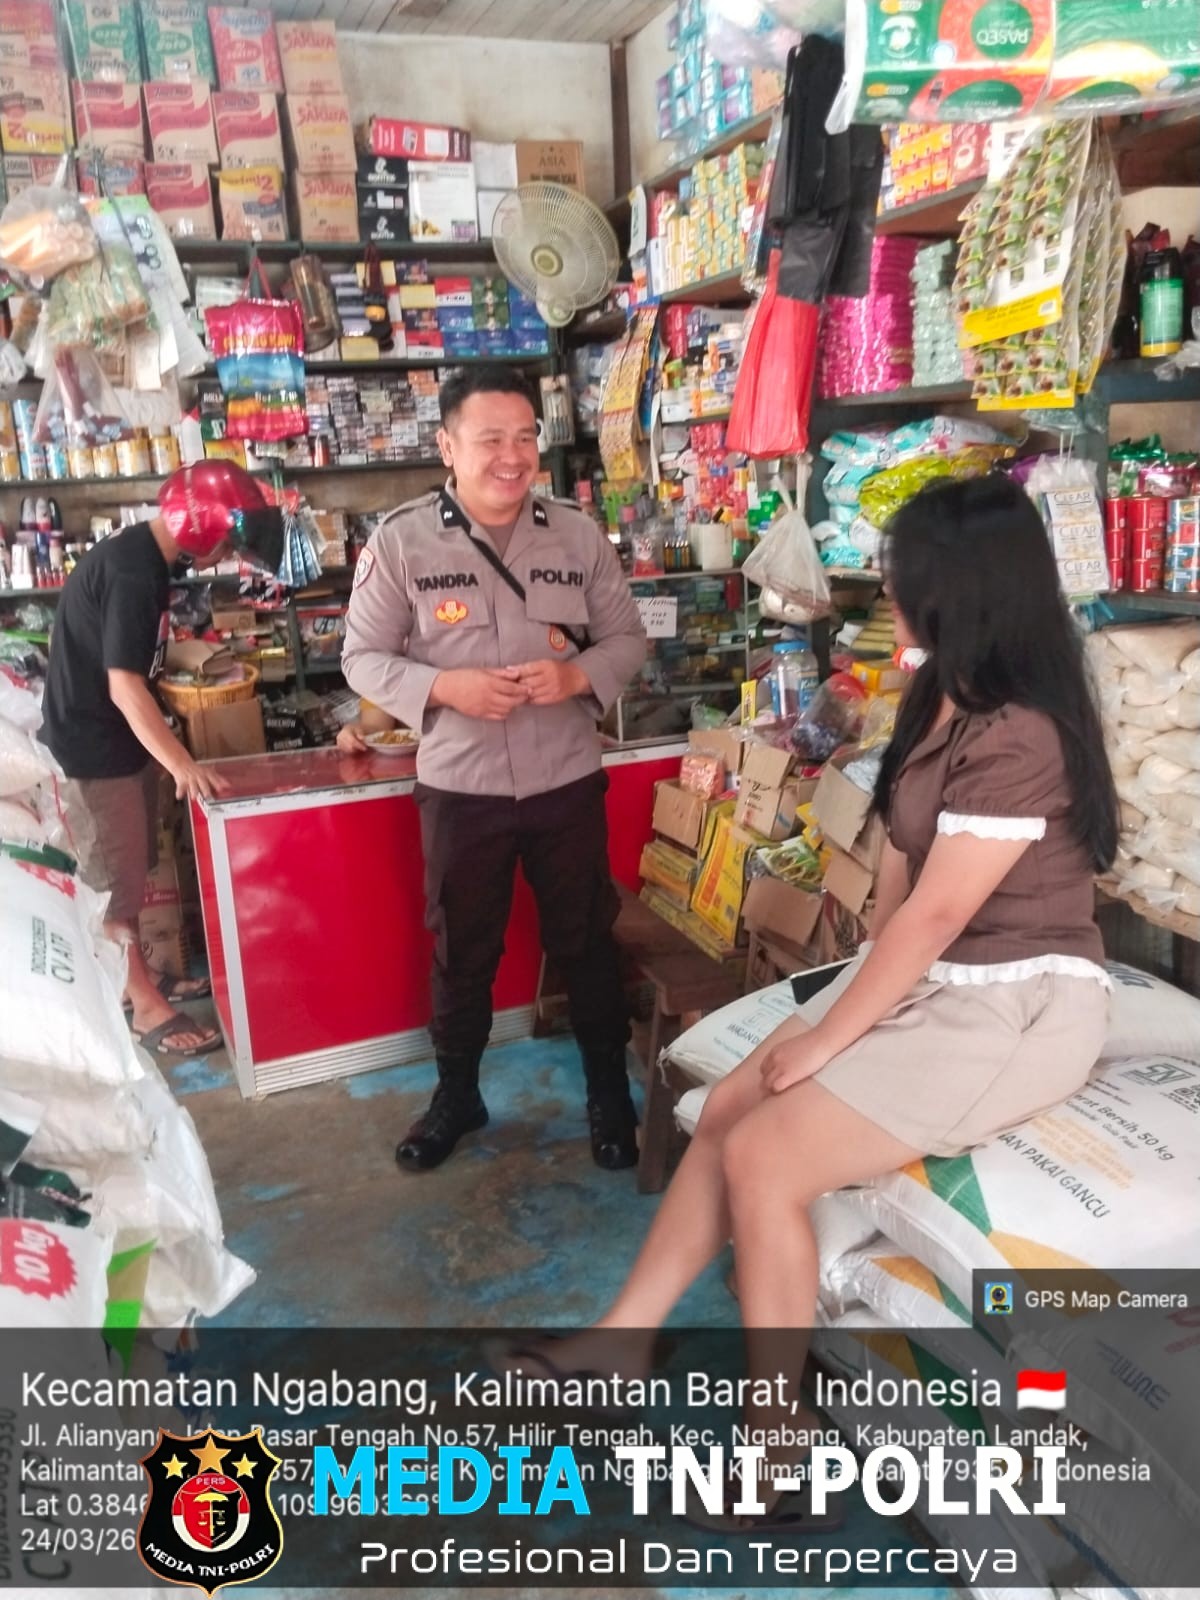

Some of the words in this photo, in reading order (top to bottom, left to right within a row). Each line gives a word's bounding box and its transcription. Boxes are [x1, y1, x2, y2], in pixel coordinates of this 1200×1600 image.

[976, 28, 1031, 46] PASEO
[1053, 492, 1091, 503] CLEAR
[1059, 525, 1097, 538] CLEAR
[1063, 560, 1101, 574] CLEAR
[414, 573, 478, 592] YANDRA
[530, 569, 583, 587] POLRI
[1098, 1106, 1139, 1133] Bersih
[1137, 1131, 1160, 1147] 50
[1154, 1143, 1176, 1162] kg
[997, 1132, 1024, 1152] AN
[1021, 1147, 1060, 1180] PAKAI
[1058, 1174, 1112, 1219] GANCU
[13, 1252, 52, 1285] 10
